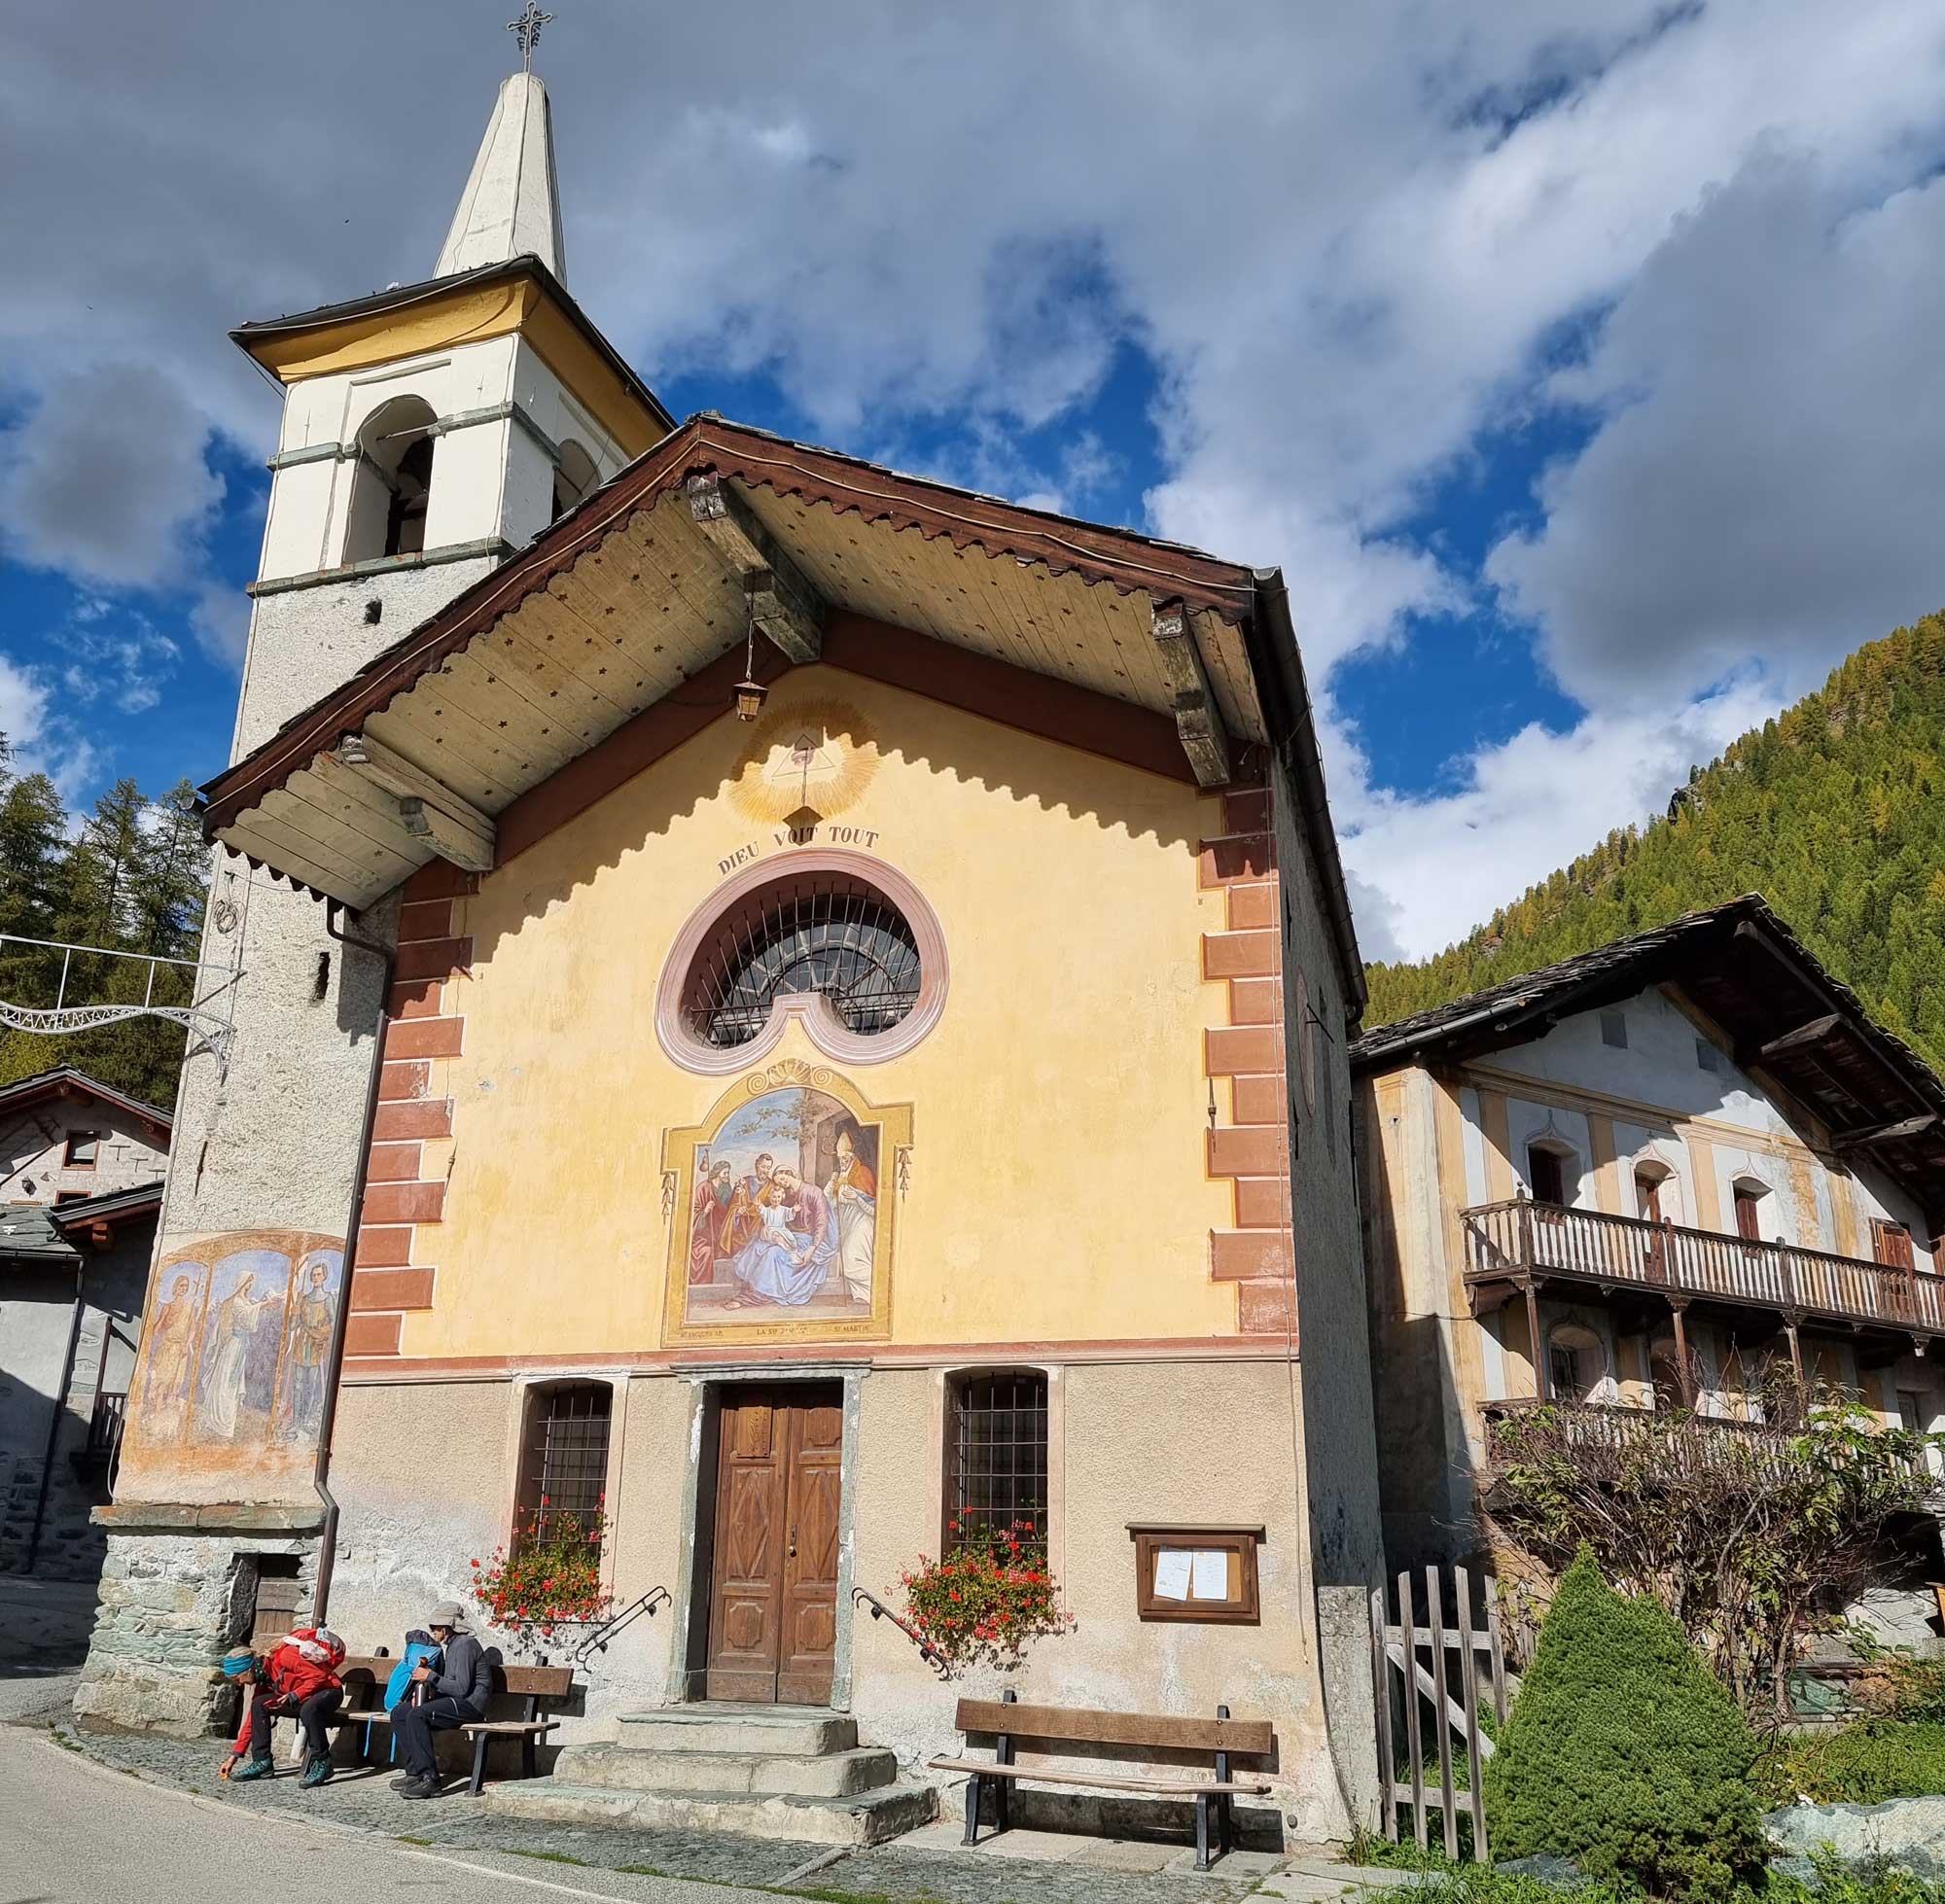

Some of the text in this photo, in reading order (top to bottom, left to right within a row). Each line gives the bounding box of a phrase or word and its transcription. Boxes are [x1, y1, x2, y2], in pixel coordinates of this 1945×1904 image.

[717, 827, 879, 875] DIEU VOIT TOUT
